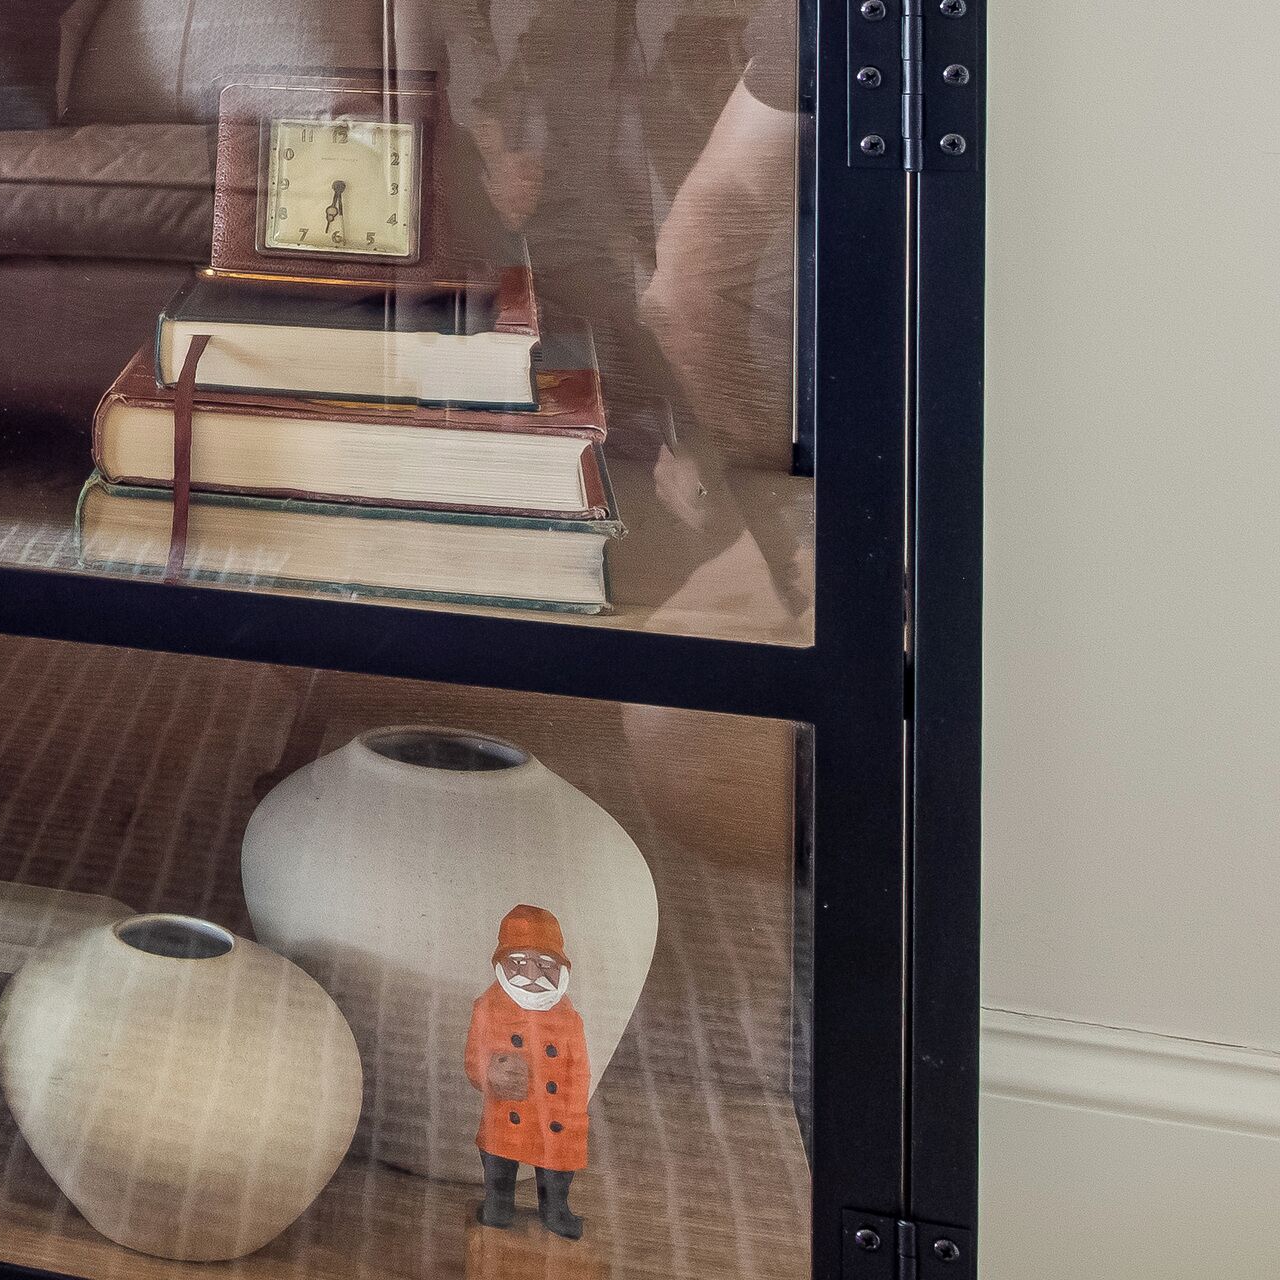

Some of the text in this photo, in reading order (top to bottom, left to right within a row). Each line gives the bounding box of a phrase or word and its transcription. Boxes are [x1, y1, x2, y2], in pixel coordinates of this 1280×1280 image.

[390, 152, 400, 166] 2
[390, 182, 399, 195] 3
[387, 213, 398, 226] 4
[298, 228, 309, 241] 7
[366, 232, 375, 245] 5
